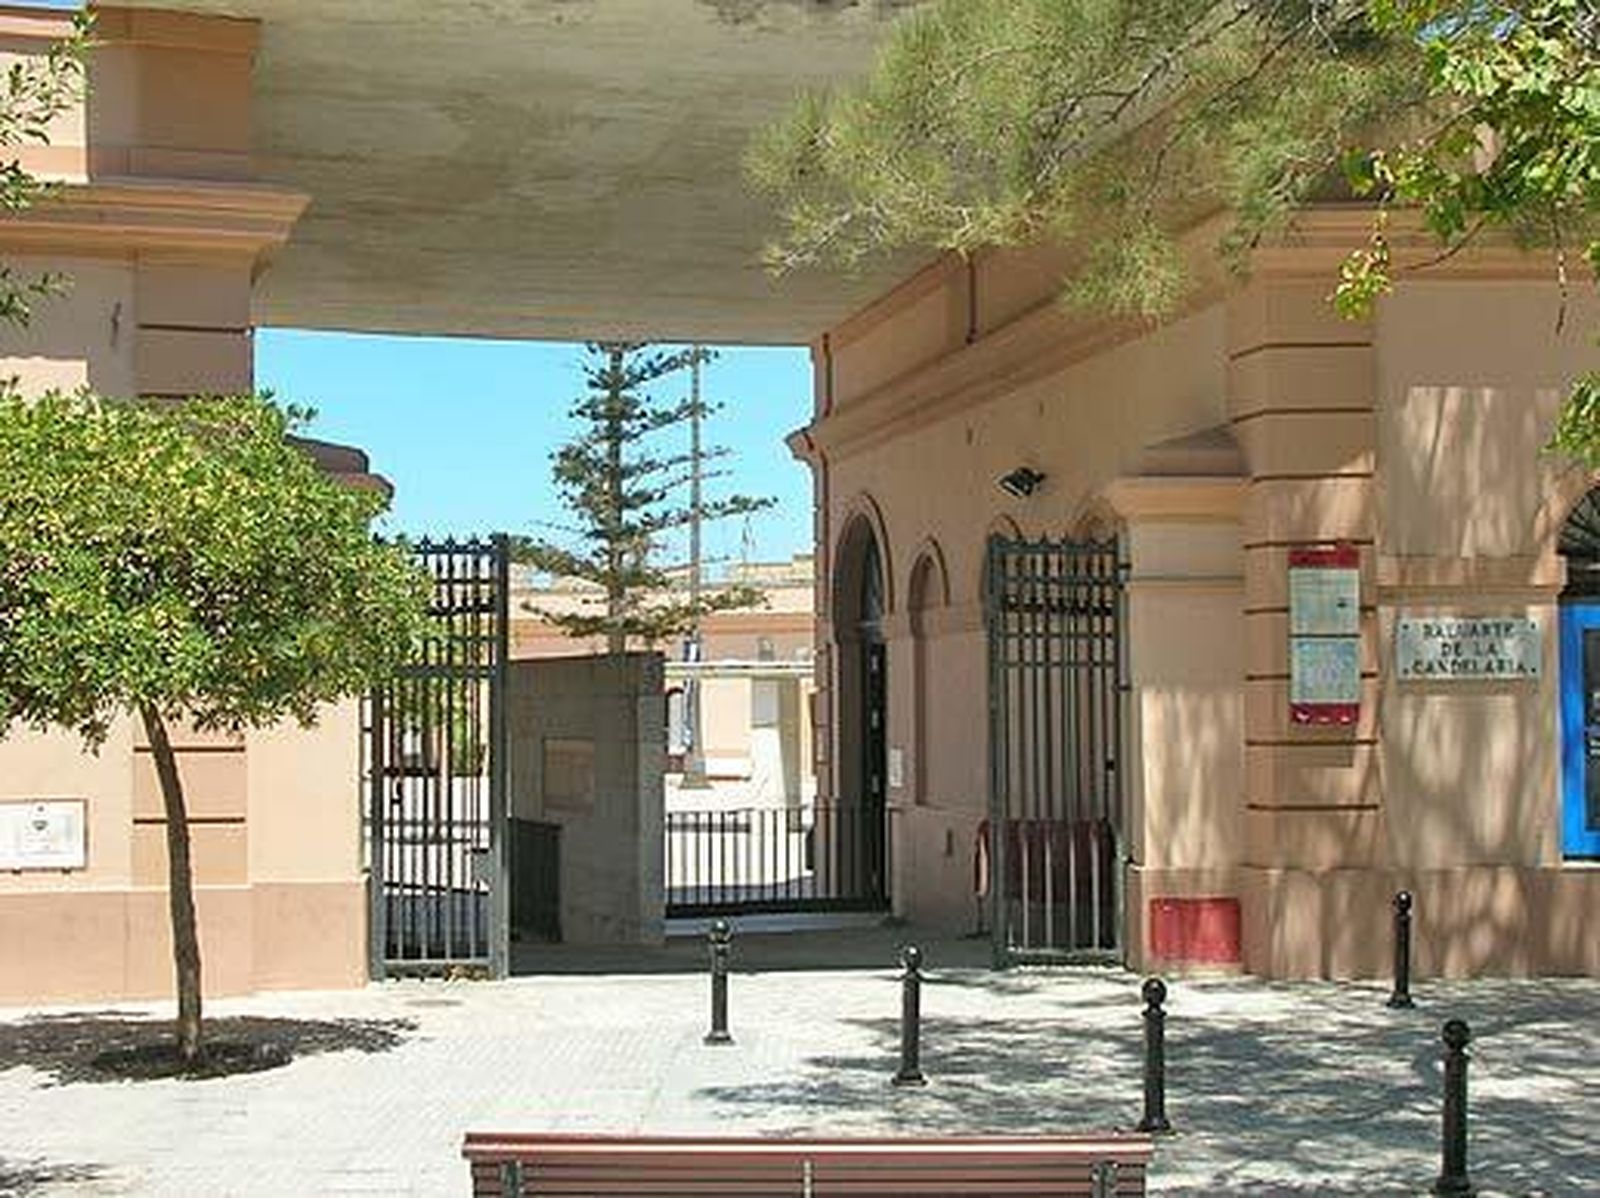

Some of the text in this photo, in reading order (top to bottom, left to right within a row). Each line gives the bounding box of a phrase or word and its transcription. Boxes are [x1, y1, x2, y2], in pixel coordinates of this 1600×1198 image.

[1441, 642, 1498, 657] DE LA
[1412, 659, 1527, 675] CANDELARIA
